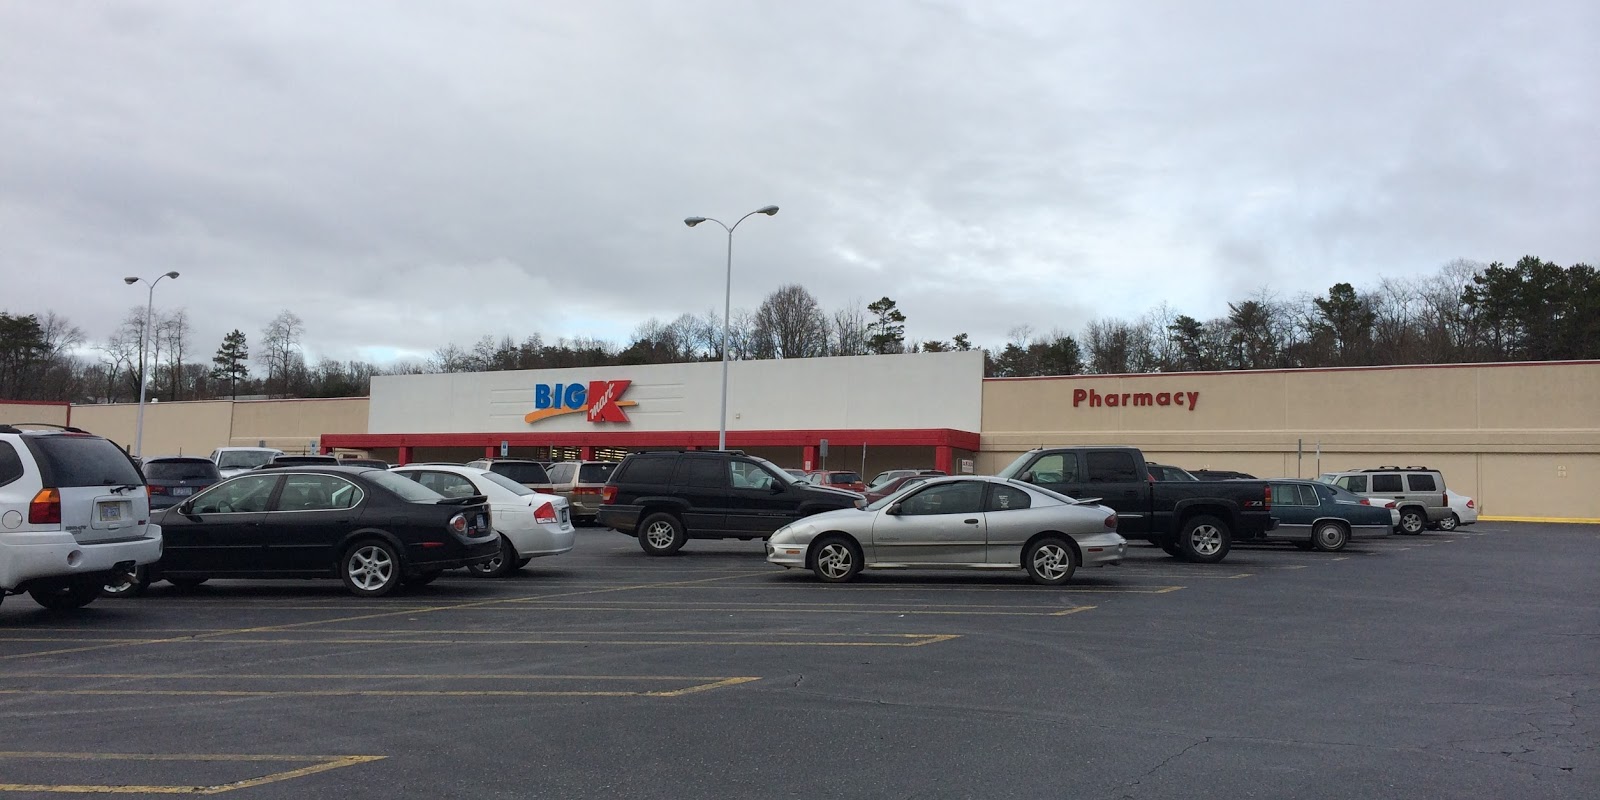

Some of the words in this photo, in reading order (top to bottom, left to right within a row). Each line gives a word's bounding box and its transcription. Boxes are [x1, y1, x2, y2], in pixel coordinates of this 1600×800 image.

[535, 383, 586, 410] BIG
[587, 380, 631, 422] K
[590, 383, 614, 419] mart
[1073, 389, 1199, 411] Pharmacy
